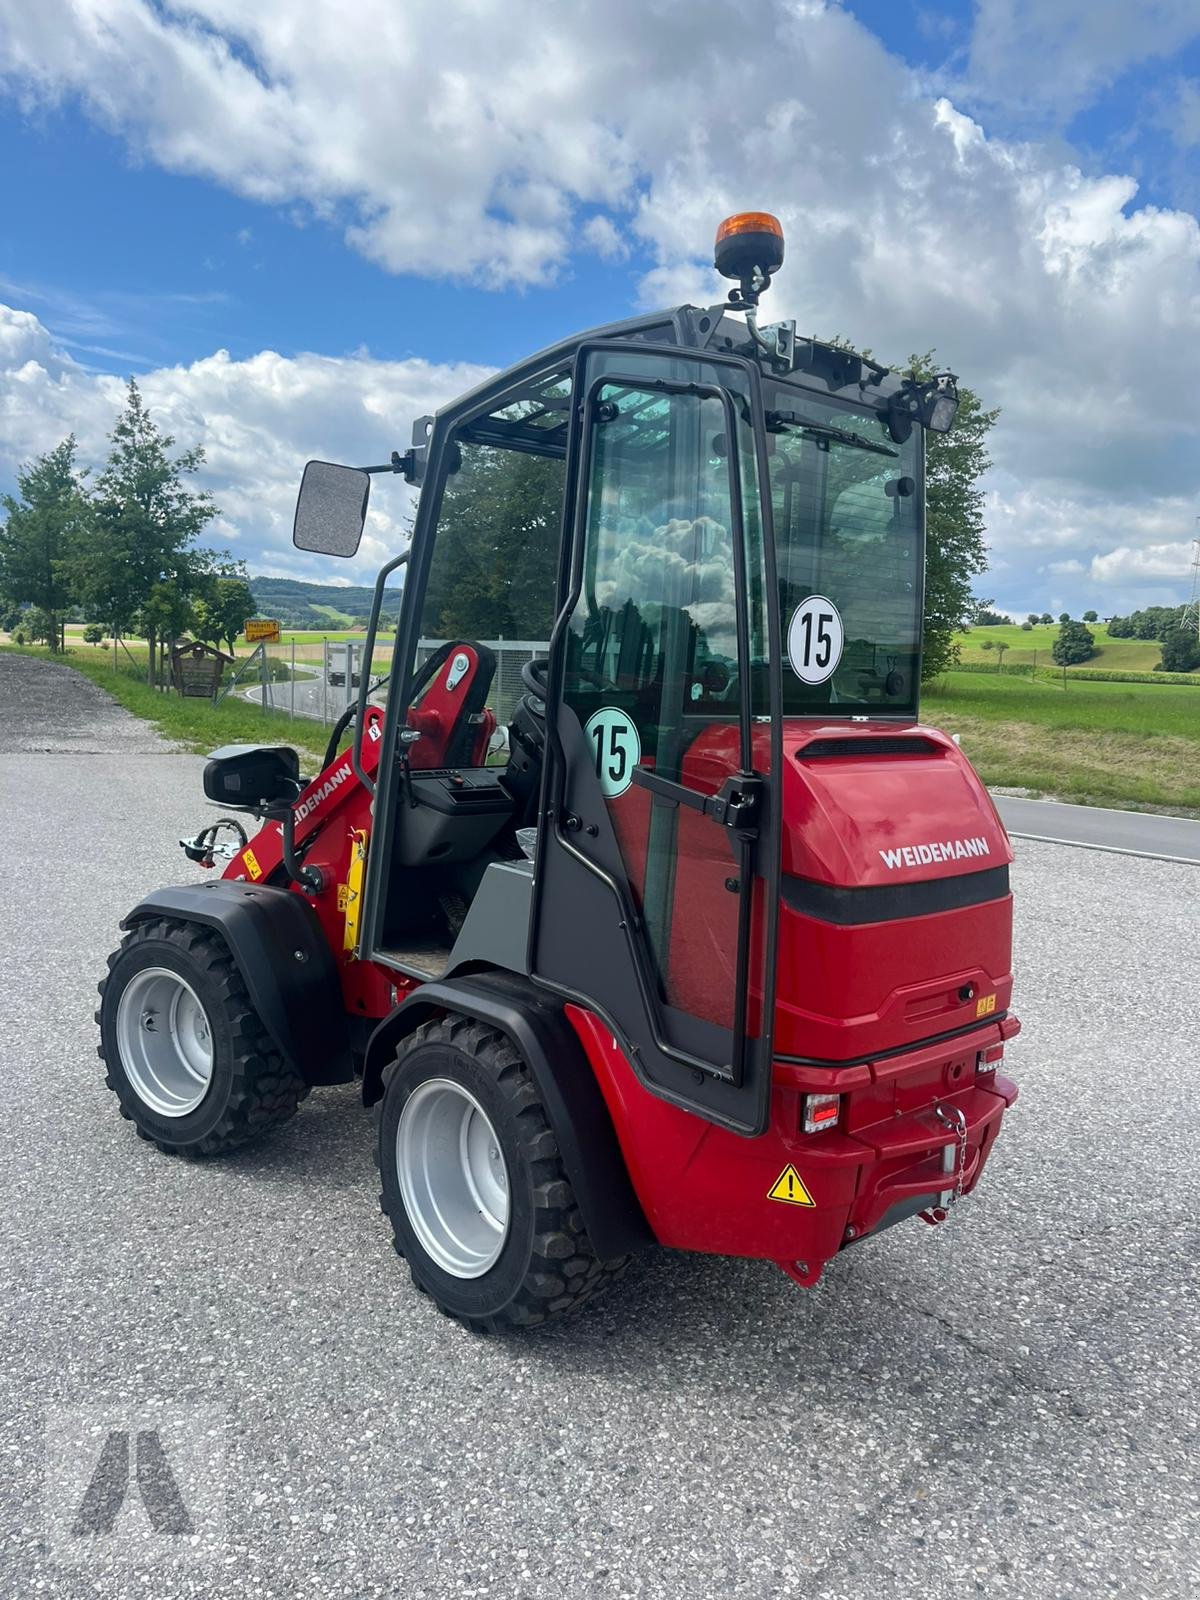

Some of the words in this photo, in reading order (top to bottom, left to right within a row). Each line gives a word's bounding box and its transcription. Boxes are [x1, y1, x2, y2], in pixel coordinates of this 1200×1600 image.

[801, 612, 833, 668] 15
[592, 724, 628, 782] 15
[879, 837, 990, 869] WEIDEMANN
